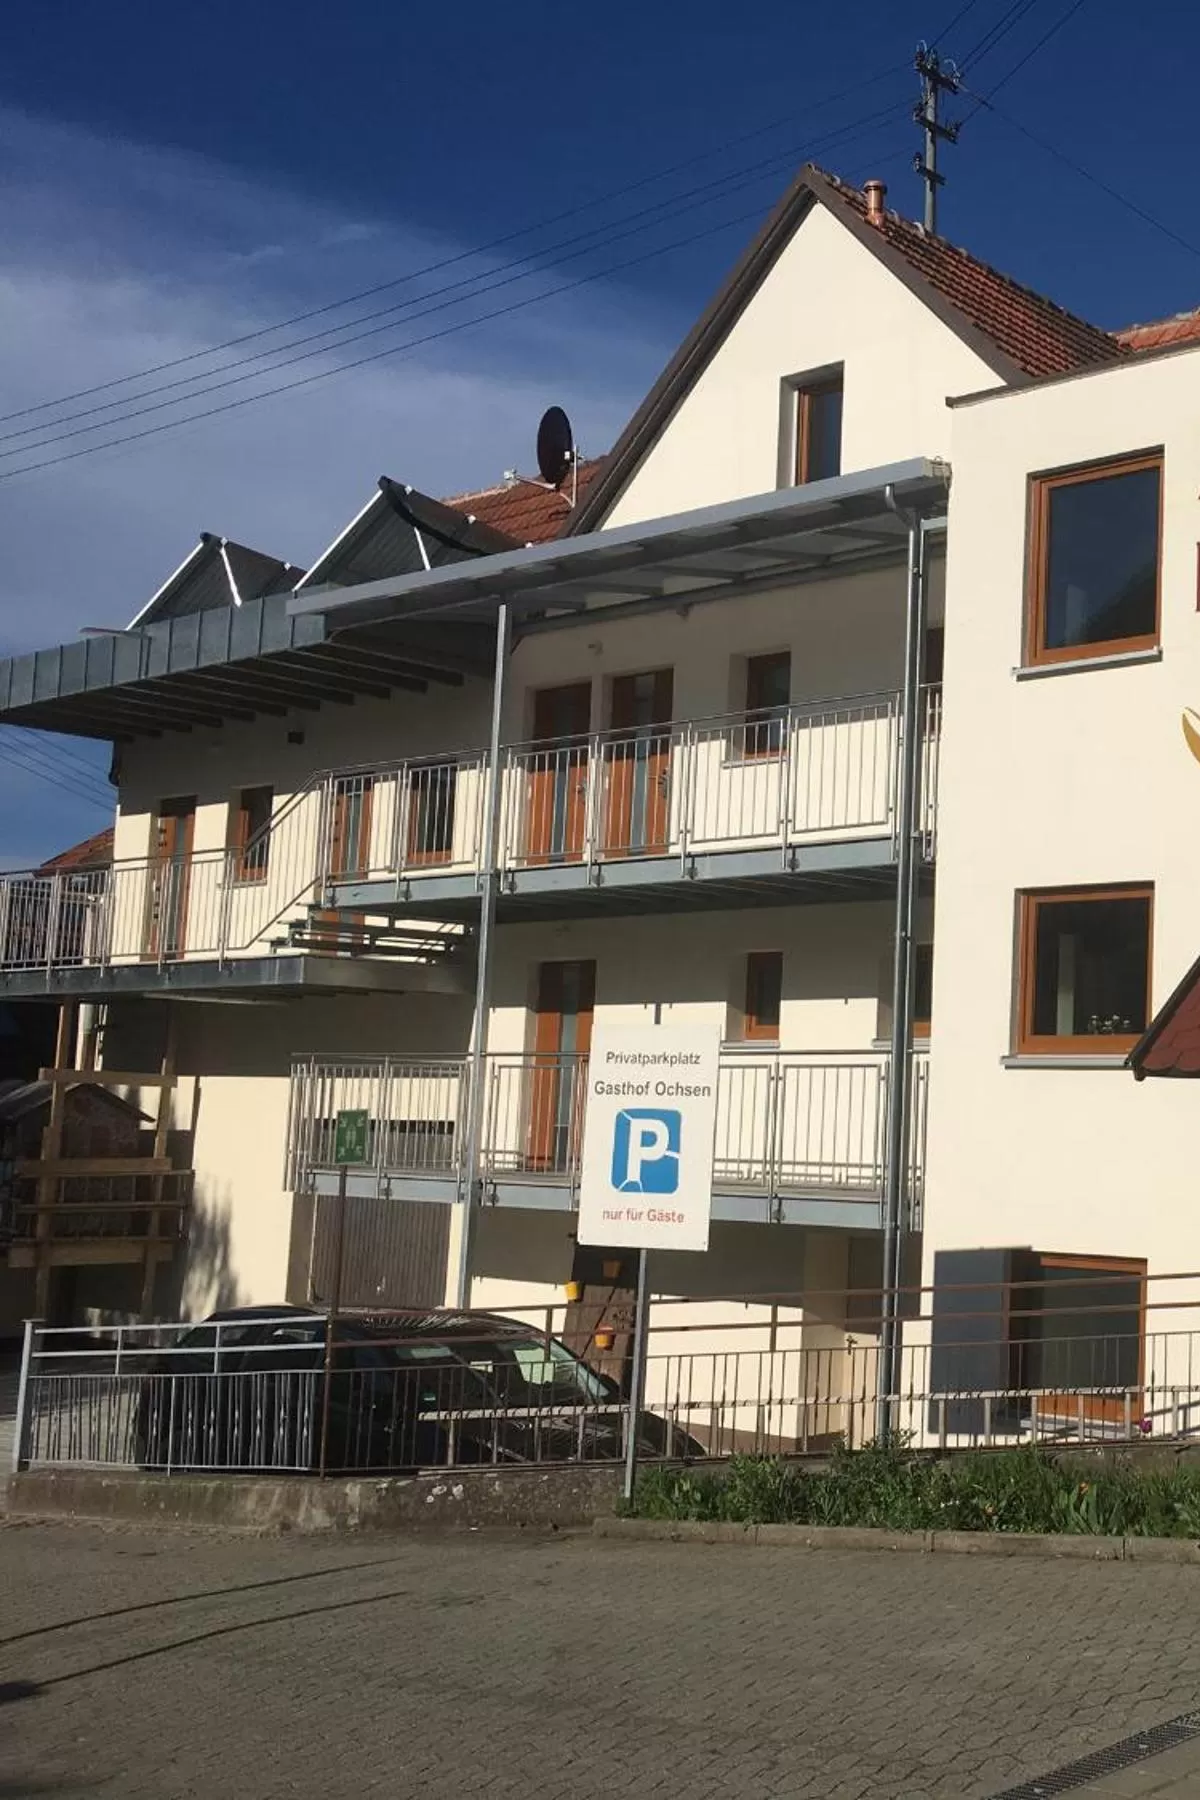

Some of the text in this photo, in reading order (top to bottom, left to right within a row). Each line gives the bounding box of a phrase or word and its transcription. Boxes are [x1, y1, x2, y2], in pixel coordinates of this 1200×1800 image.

[606, 1051, 700, 1067] Privatparkplatz
[594, 1080, 711, 1097] Gasthof Ochsen
[627, 1119, 669, 1181] P
[602, 1207, 685, 1223] nur für Gäste
